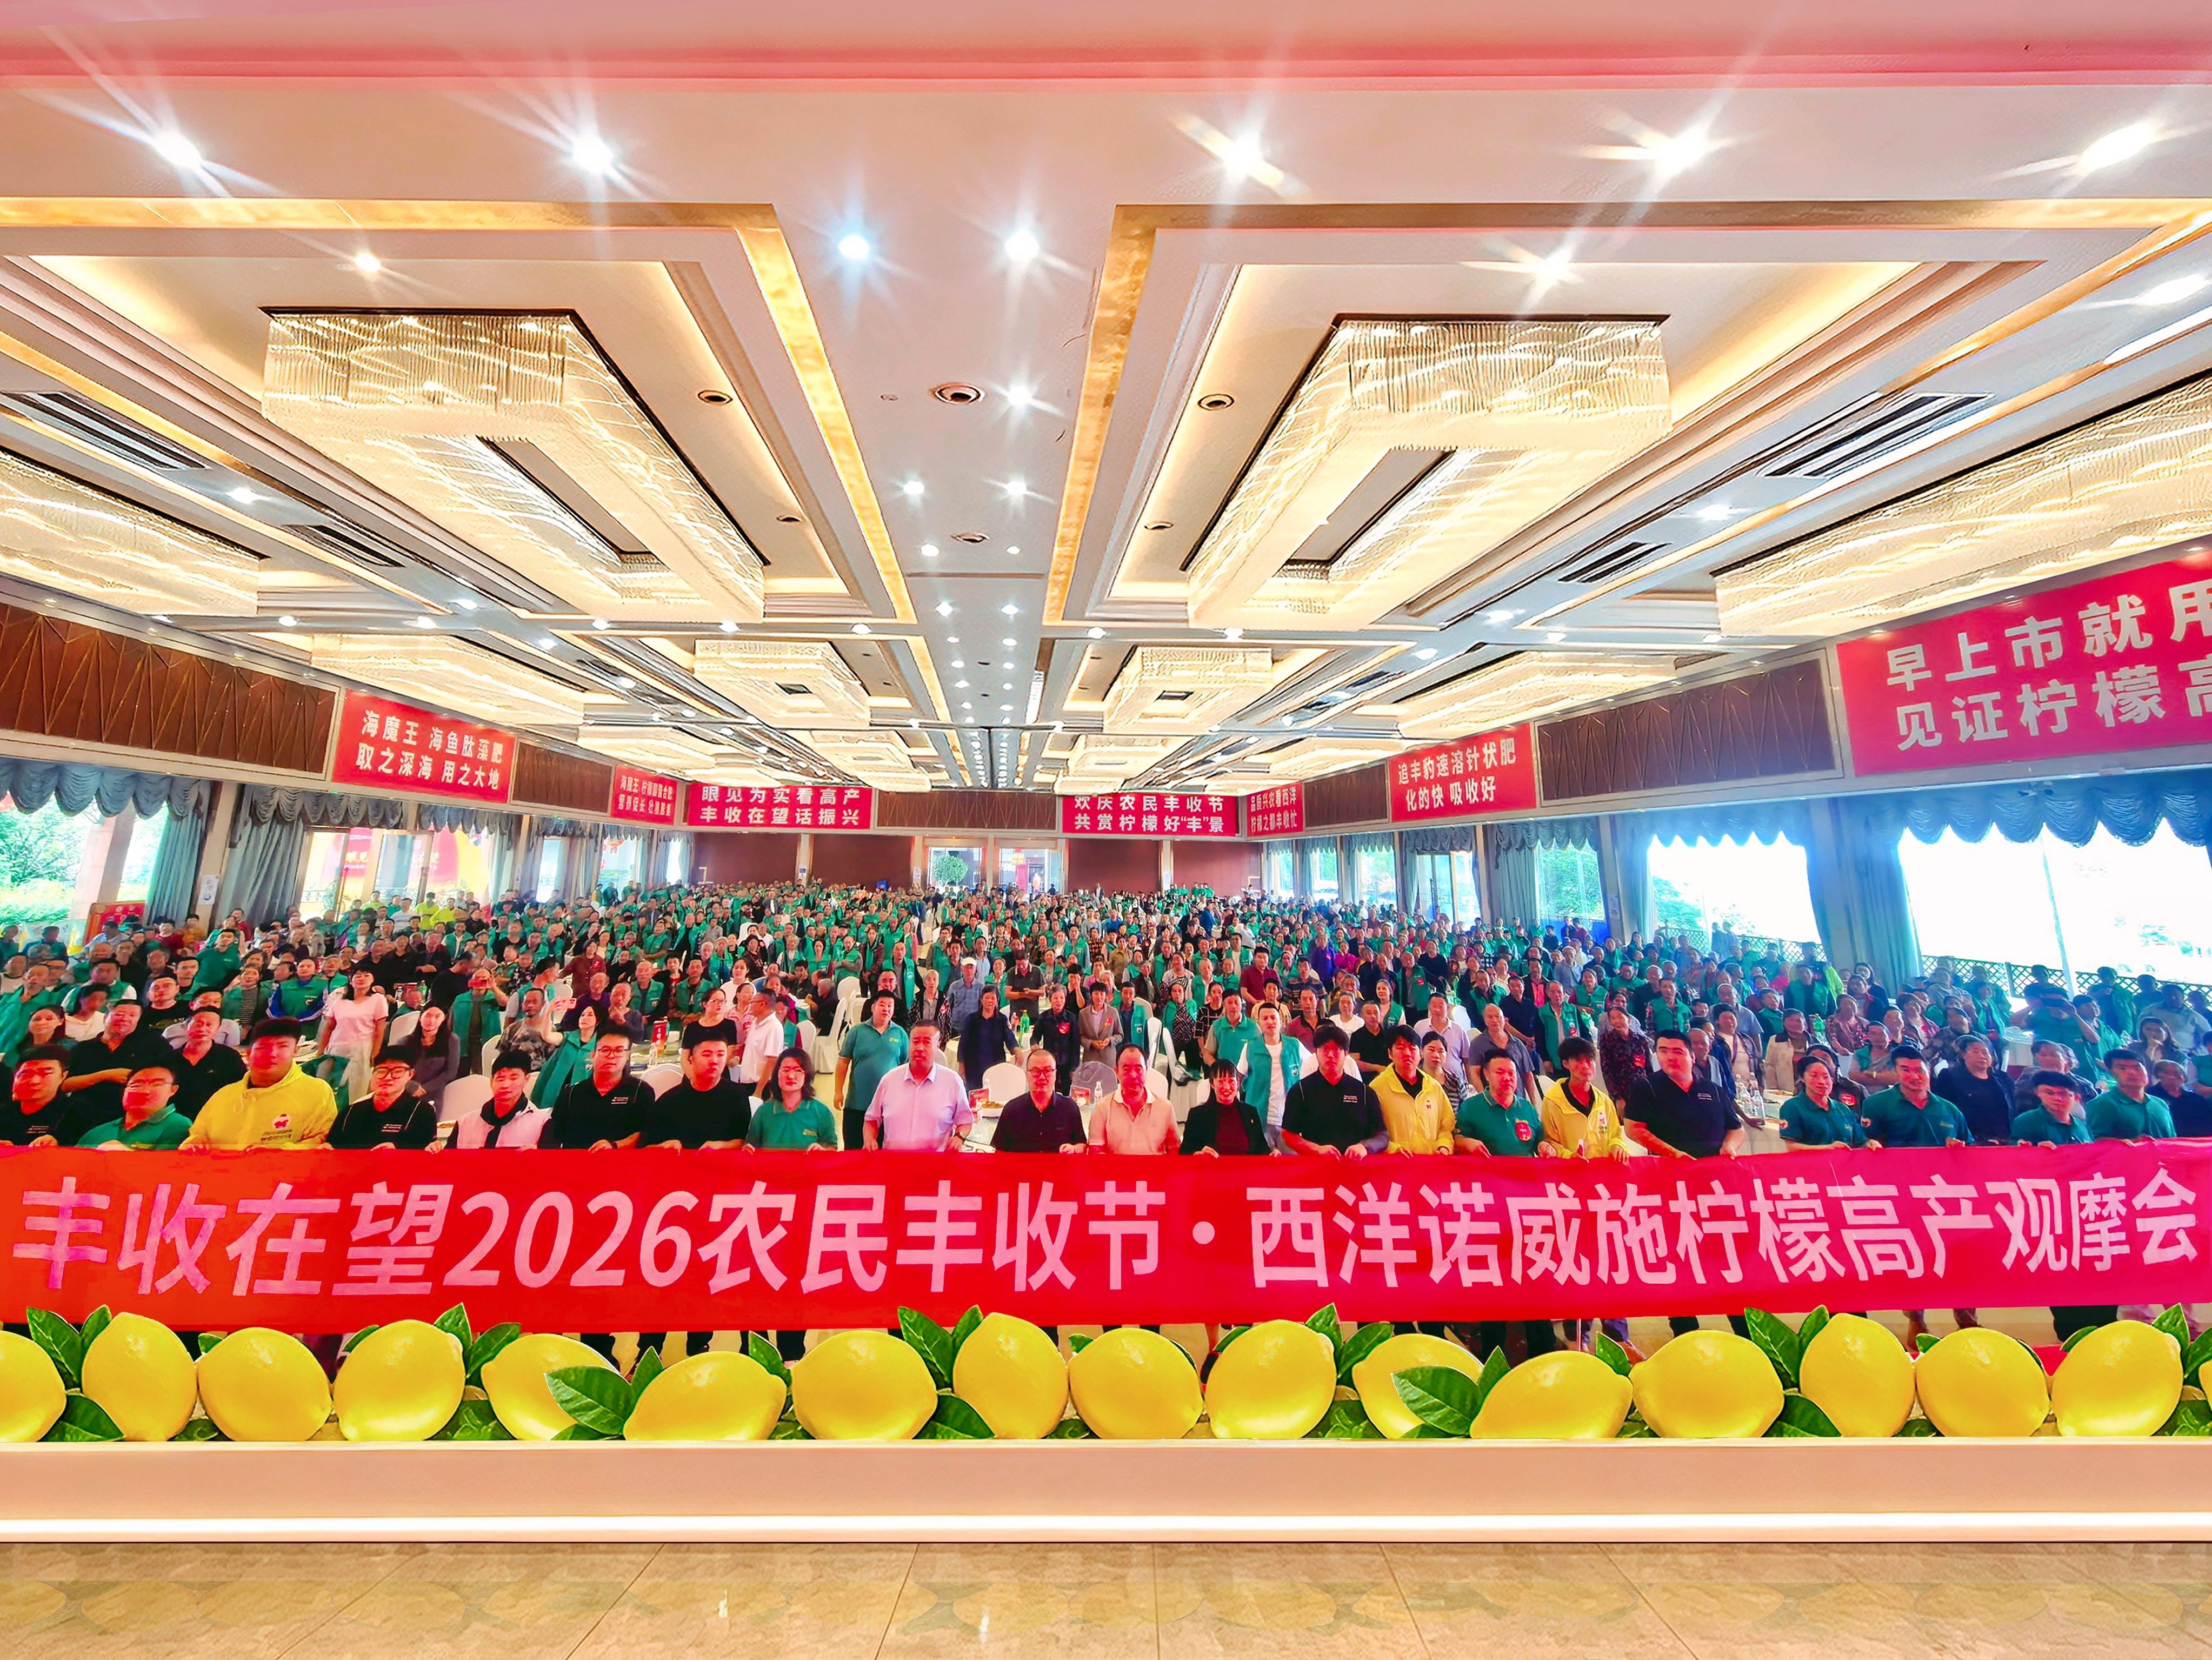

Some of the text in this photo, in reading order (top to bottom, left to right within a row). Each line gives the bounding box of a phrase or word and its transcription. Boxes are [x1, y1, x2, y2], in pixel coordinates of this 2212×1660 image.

[1886, 578, 2211, 692] 早上市就用
[361, 709, 419, 746] 海魔王
[355, 742, 499, 790] 取之深海 用之大地
[1398, 738, 1516, 785] 追丰豹速溶针状肥
[702, 786, 860, 805] 眼见为实看高产
[1074, 795, 1223, 813] 欢庆农民丰收节
[1406, 776, 1496, 812] 化的快 吸收好
[700, 806, 860, 826] 丰收在望话振兴
